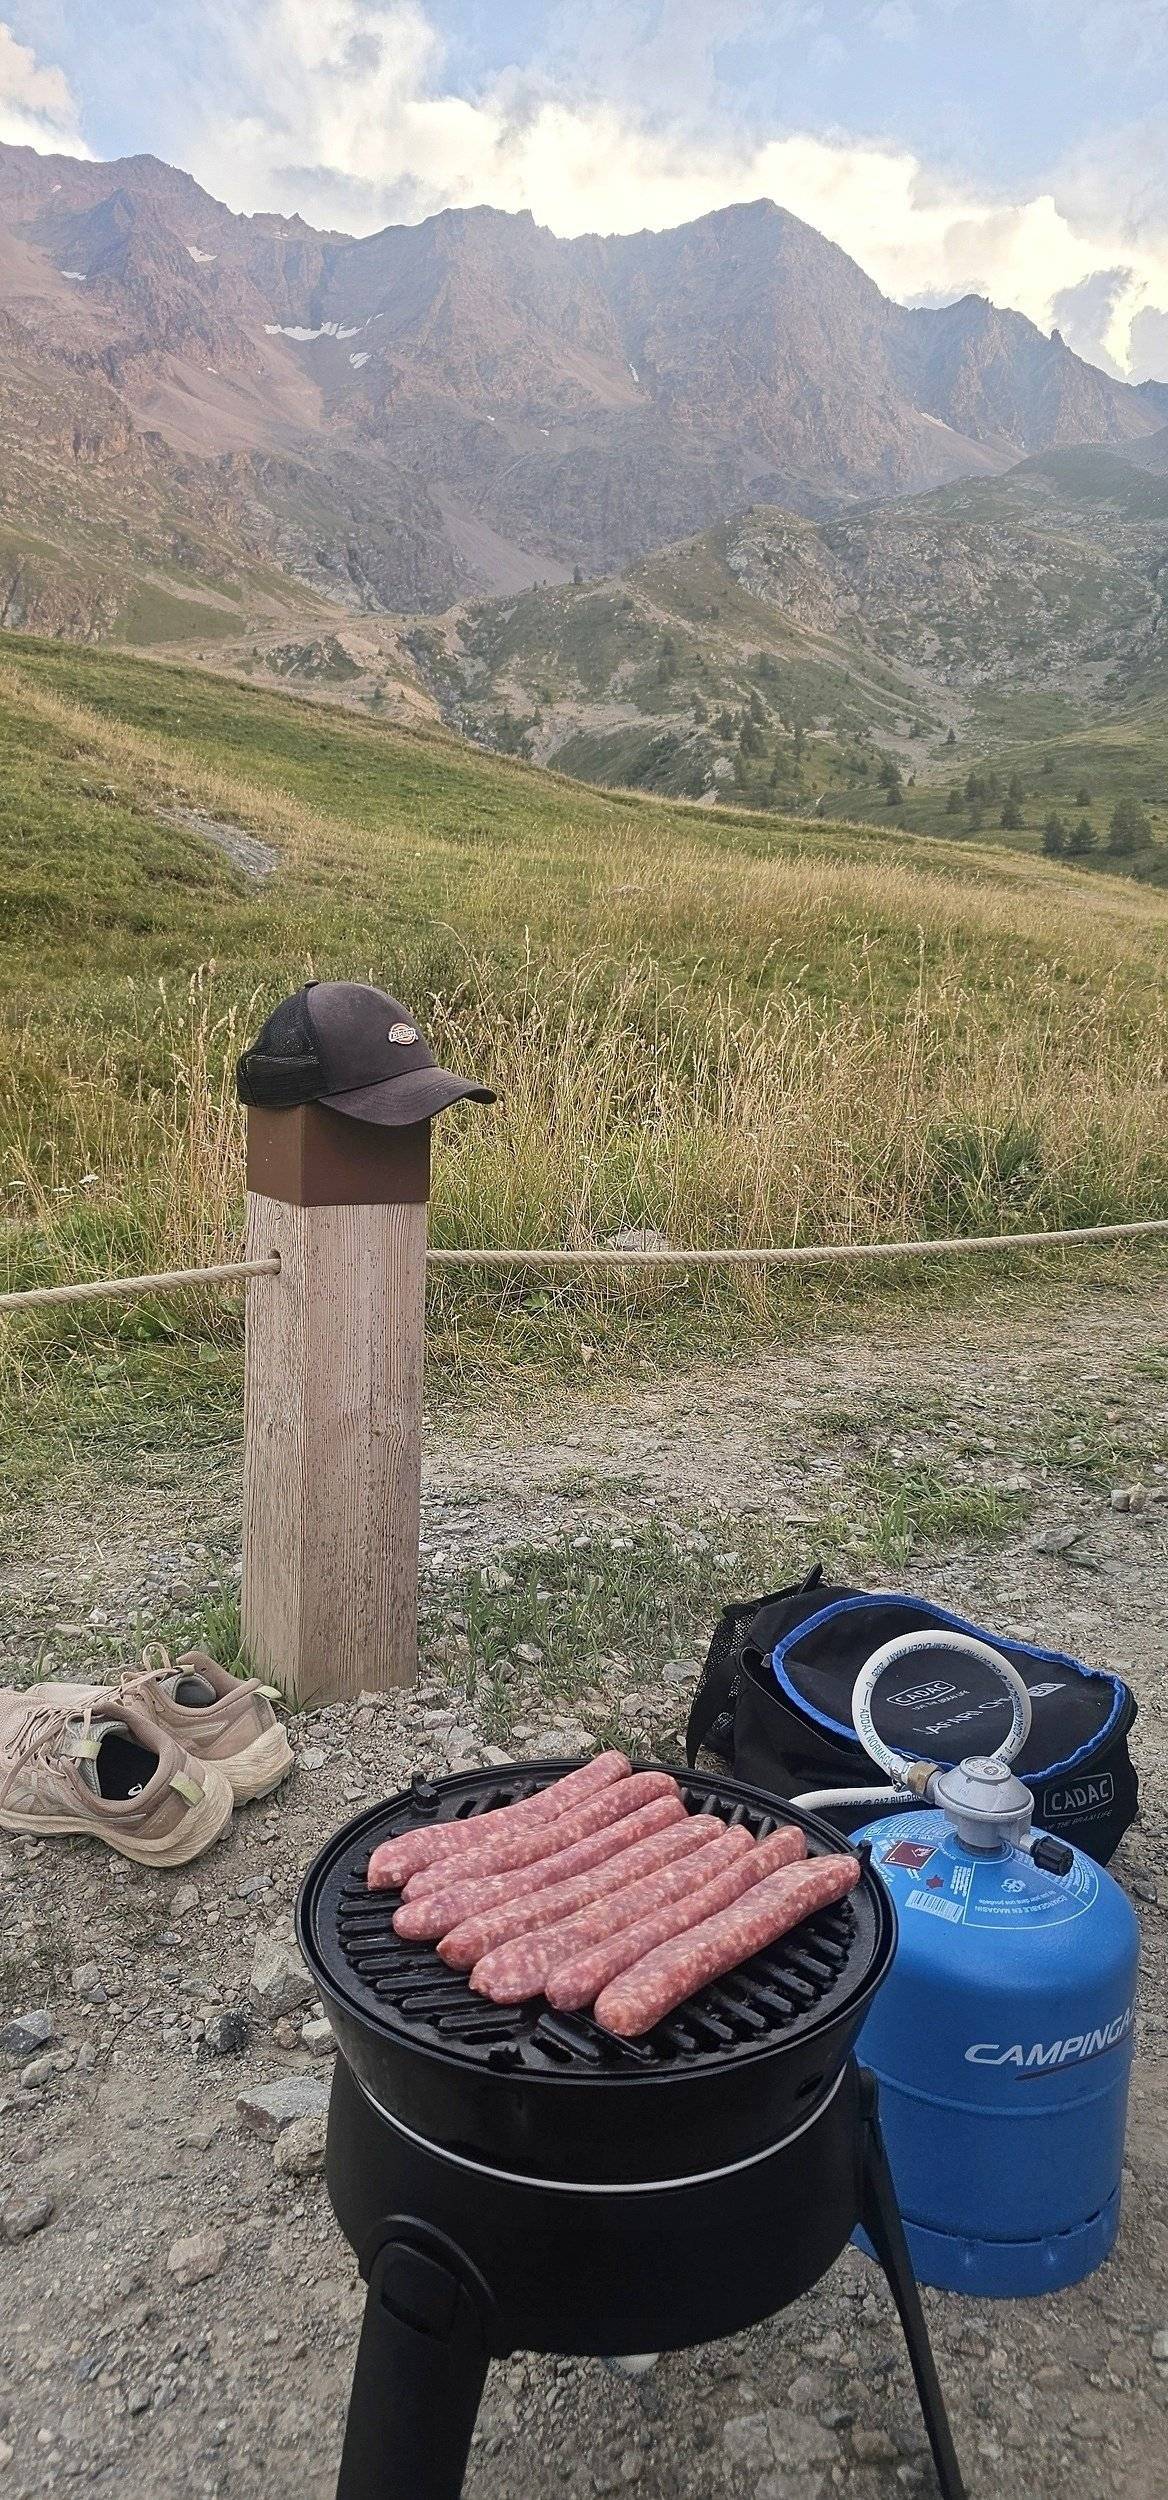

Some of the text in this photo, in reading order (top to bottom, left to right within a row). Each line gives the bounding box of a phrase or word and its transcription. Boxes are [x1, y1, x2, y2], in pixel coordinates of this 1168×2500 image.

[896, 1681, 951, 1704] CADAC
[858, 1708, 873, 1737] ADDAX
[1051, 1779, 1109, 1811] CADAC
[964, 2004, 1135, 2067] CAMPINGA
